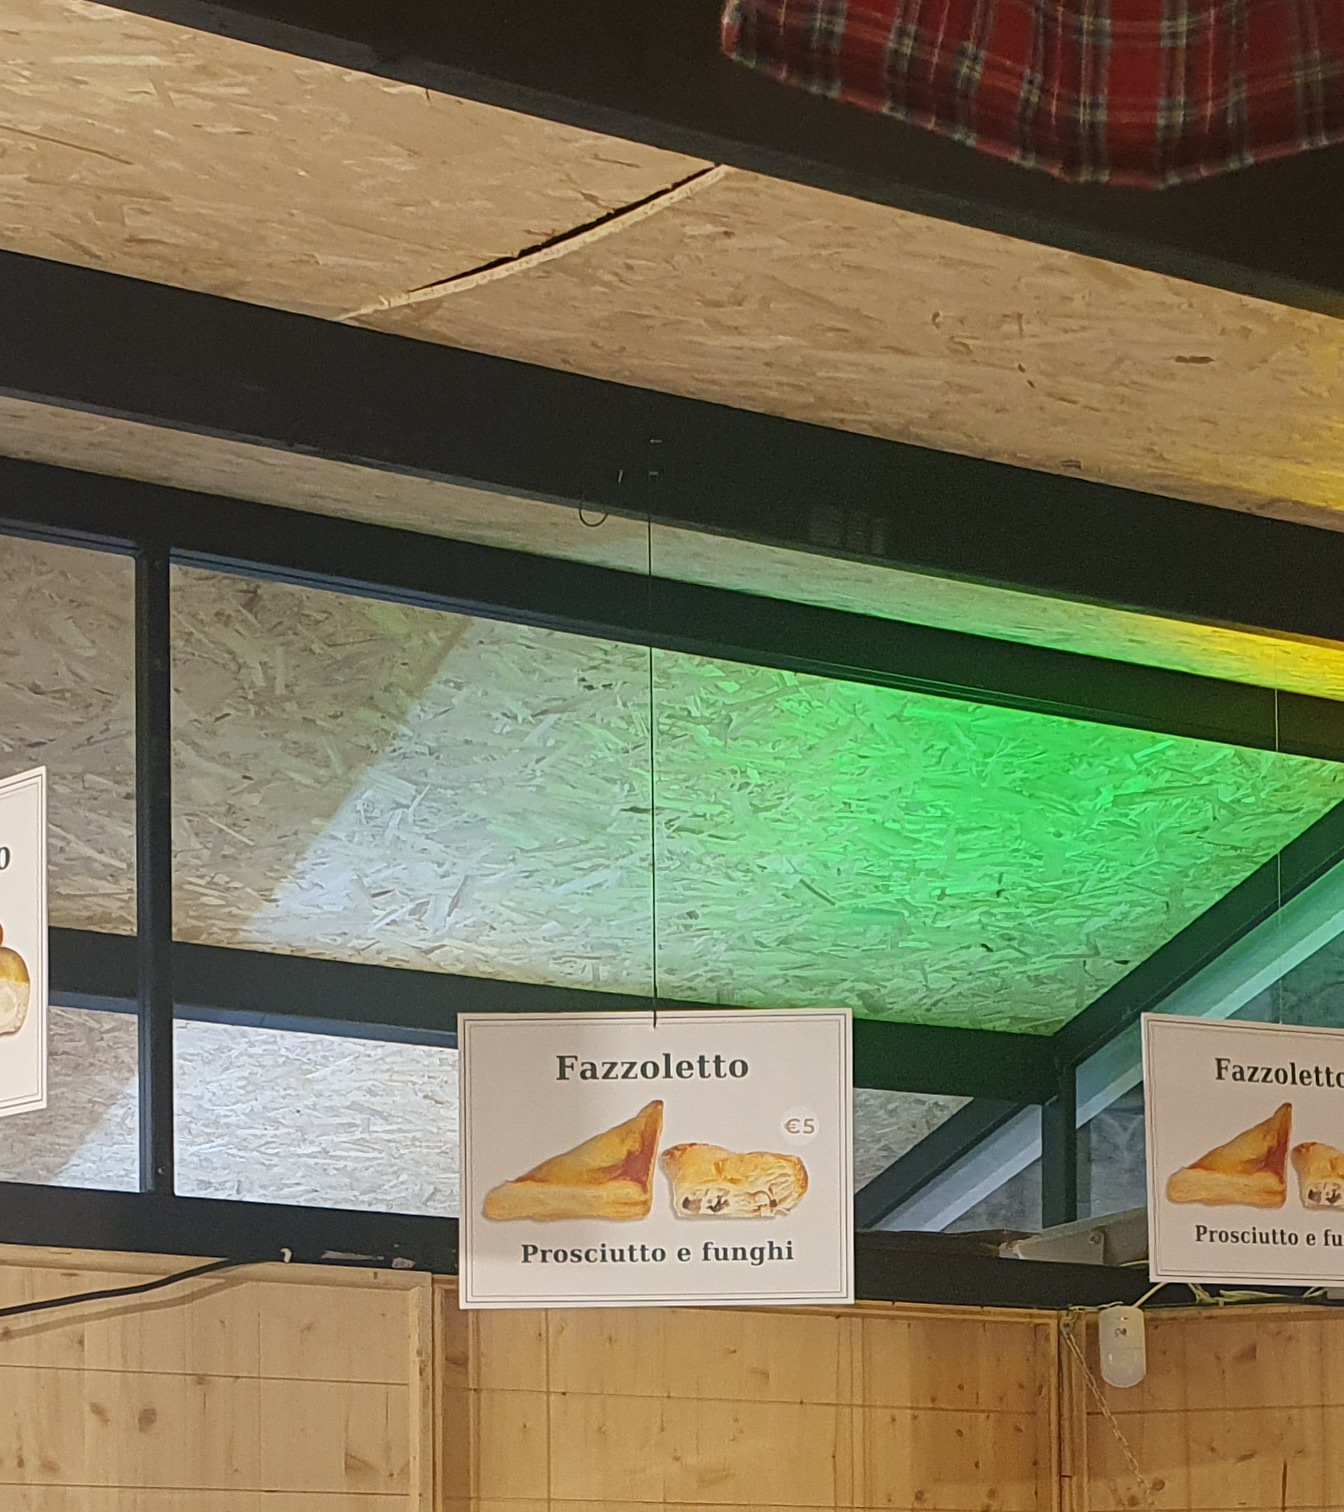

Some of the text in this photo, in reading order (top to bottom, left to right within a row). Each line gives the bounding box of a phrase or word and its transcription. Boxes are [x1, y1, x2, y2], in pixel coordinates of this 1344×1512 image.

[555, 1052, 750, 1081] Fazzoletto
[784, 1118, 816, 1135] €5
[1195, 1224, 1299, 1246] Prosciutto
[1306, 1233, 1316, 1246] e
[521, 1240, 795, 1266] Prosciutto e funghi
